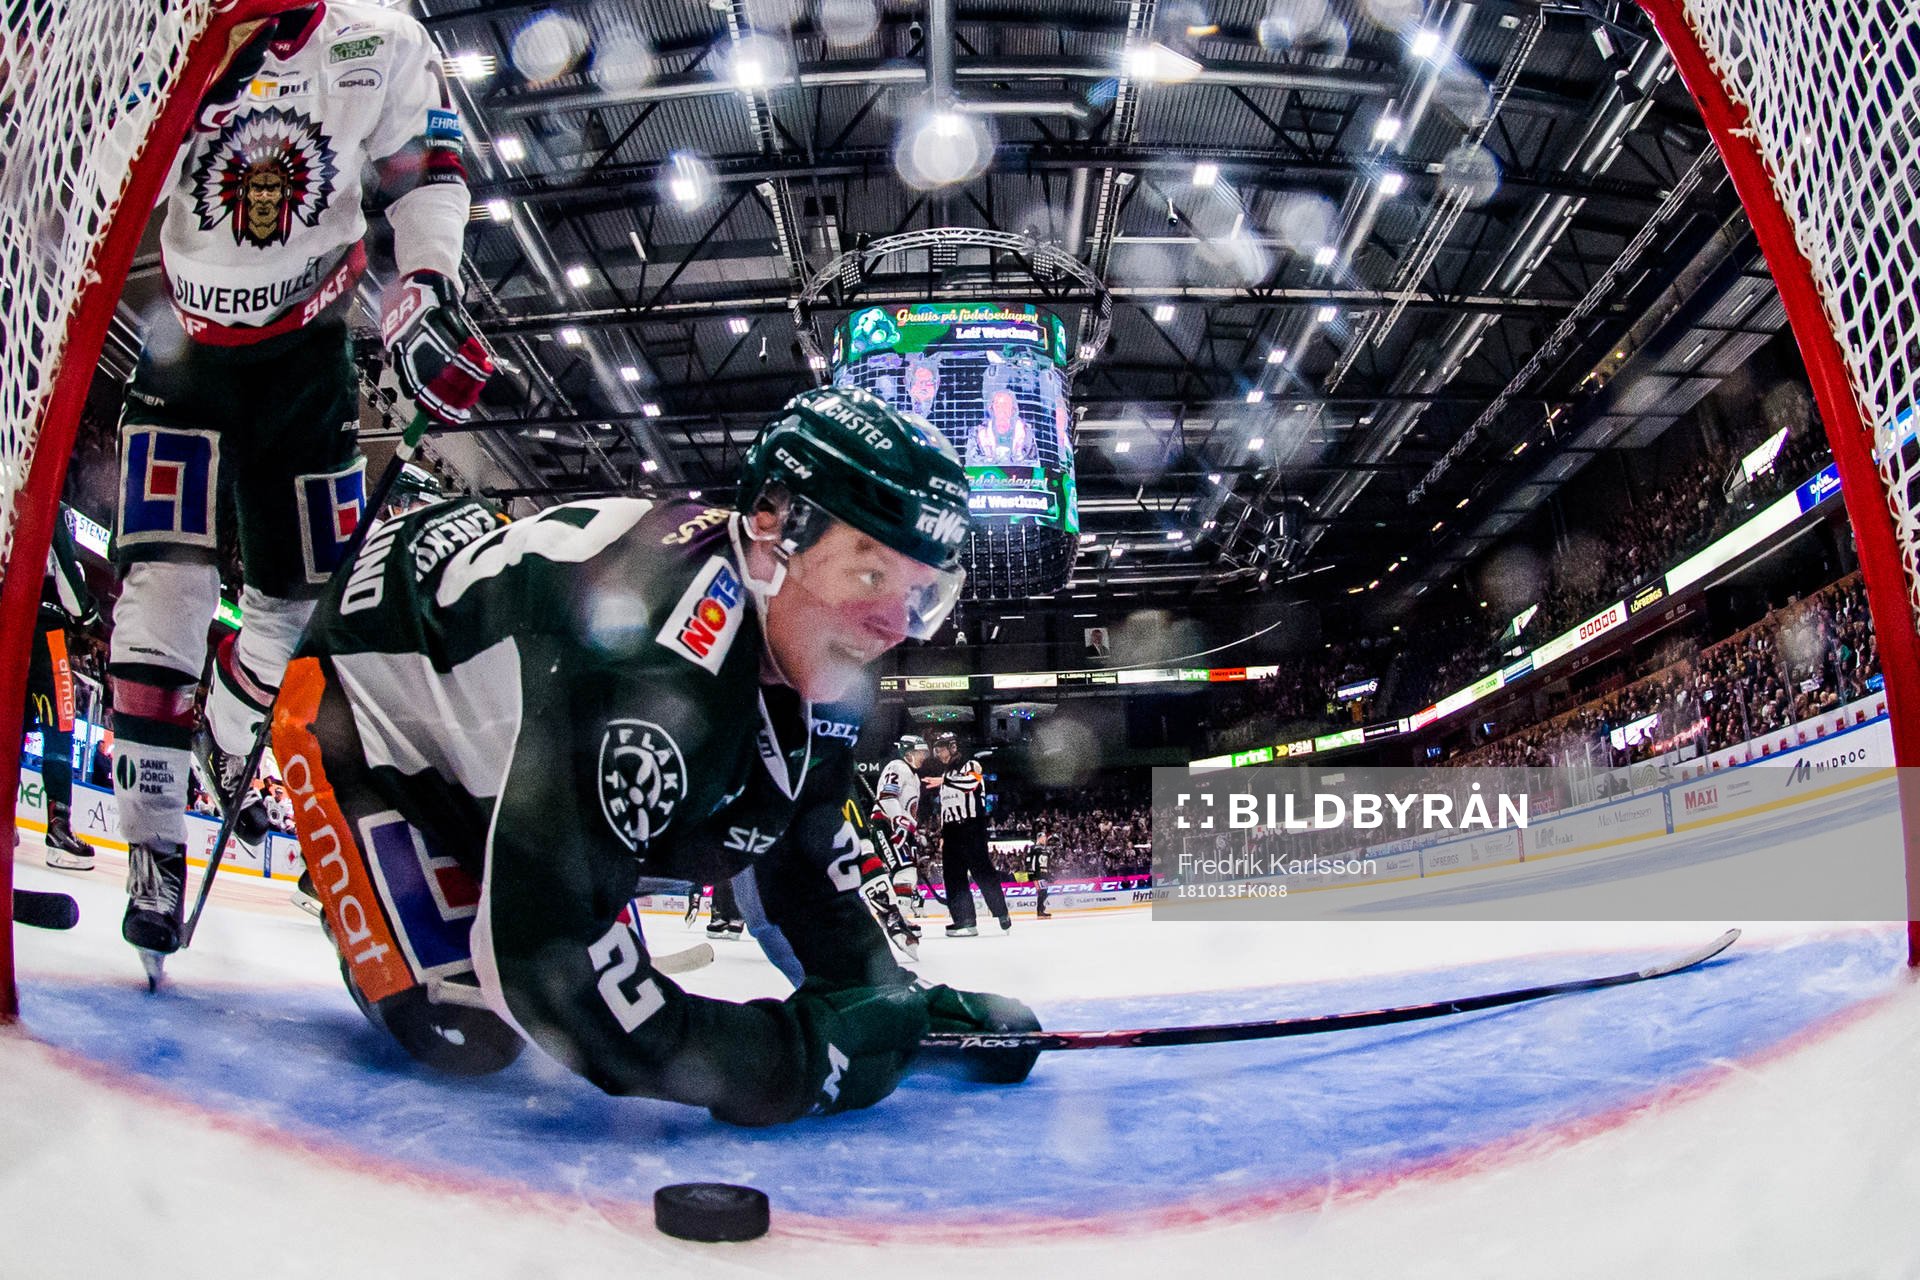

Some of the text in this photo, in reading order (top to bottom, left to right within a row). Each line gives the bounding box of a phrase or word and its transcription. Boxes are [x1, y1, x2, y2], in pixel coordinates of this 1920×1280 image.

[339, 79, 375, 88] BOHUS
[302, 265, 348, 326] SKF
[941, 311, 957, 324] på
[955, 327, 981, 340] Leif
[812, 396, 893, 450] TCHSTEP
[775, 447, 813, 480] CCM
[968, 495, 986, 509] eif
[79, 516, 109, 545] STENA
[1288, 739, 1313, 755] PSM
[139, 759, 168, 769] SANKT
[1235, 749, 1268, 766] print
[1816, 748, 1866, 774] MIDROC
[139, 770, 174, 783] JÖRGEN
[139, 783, 163, 794] PARK
[1684, 785, 1718, 810] MAXI
[284, 754, 390, 966] armat
[827, 820, 861, 892] 2
[1132, 889, 1169, 902] Hyrbilar
[587, 923, 667, 1034] 2
[960, 1037, 1020, 1049] TACKS
